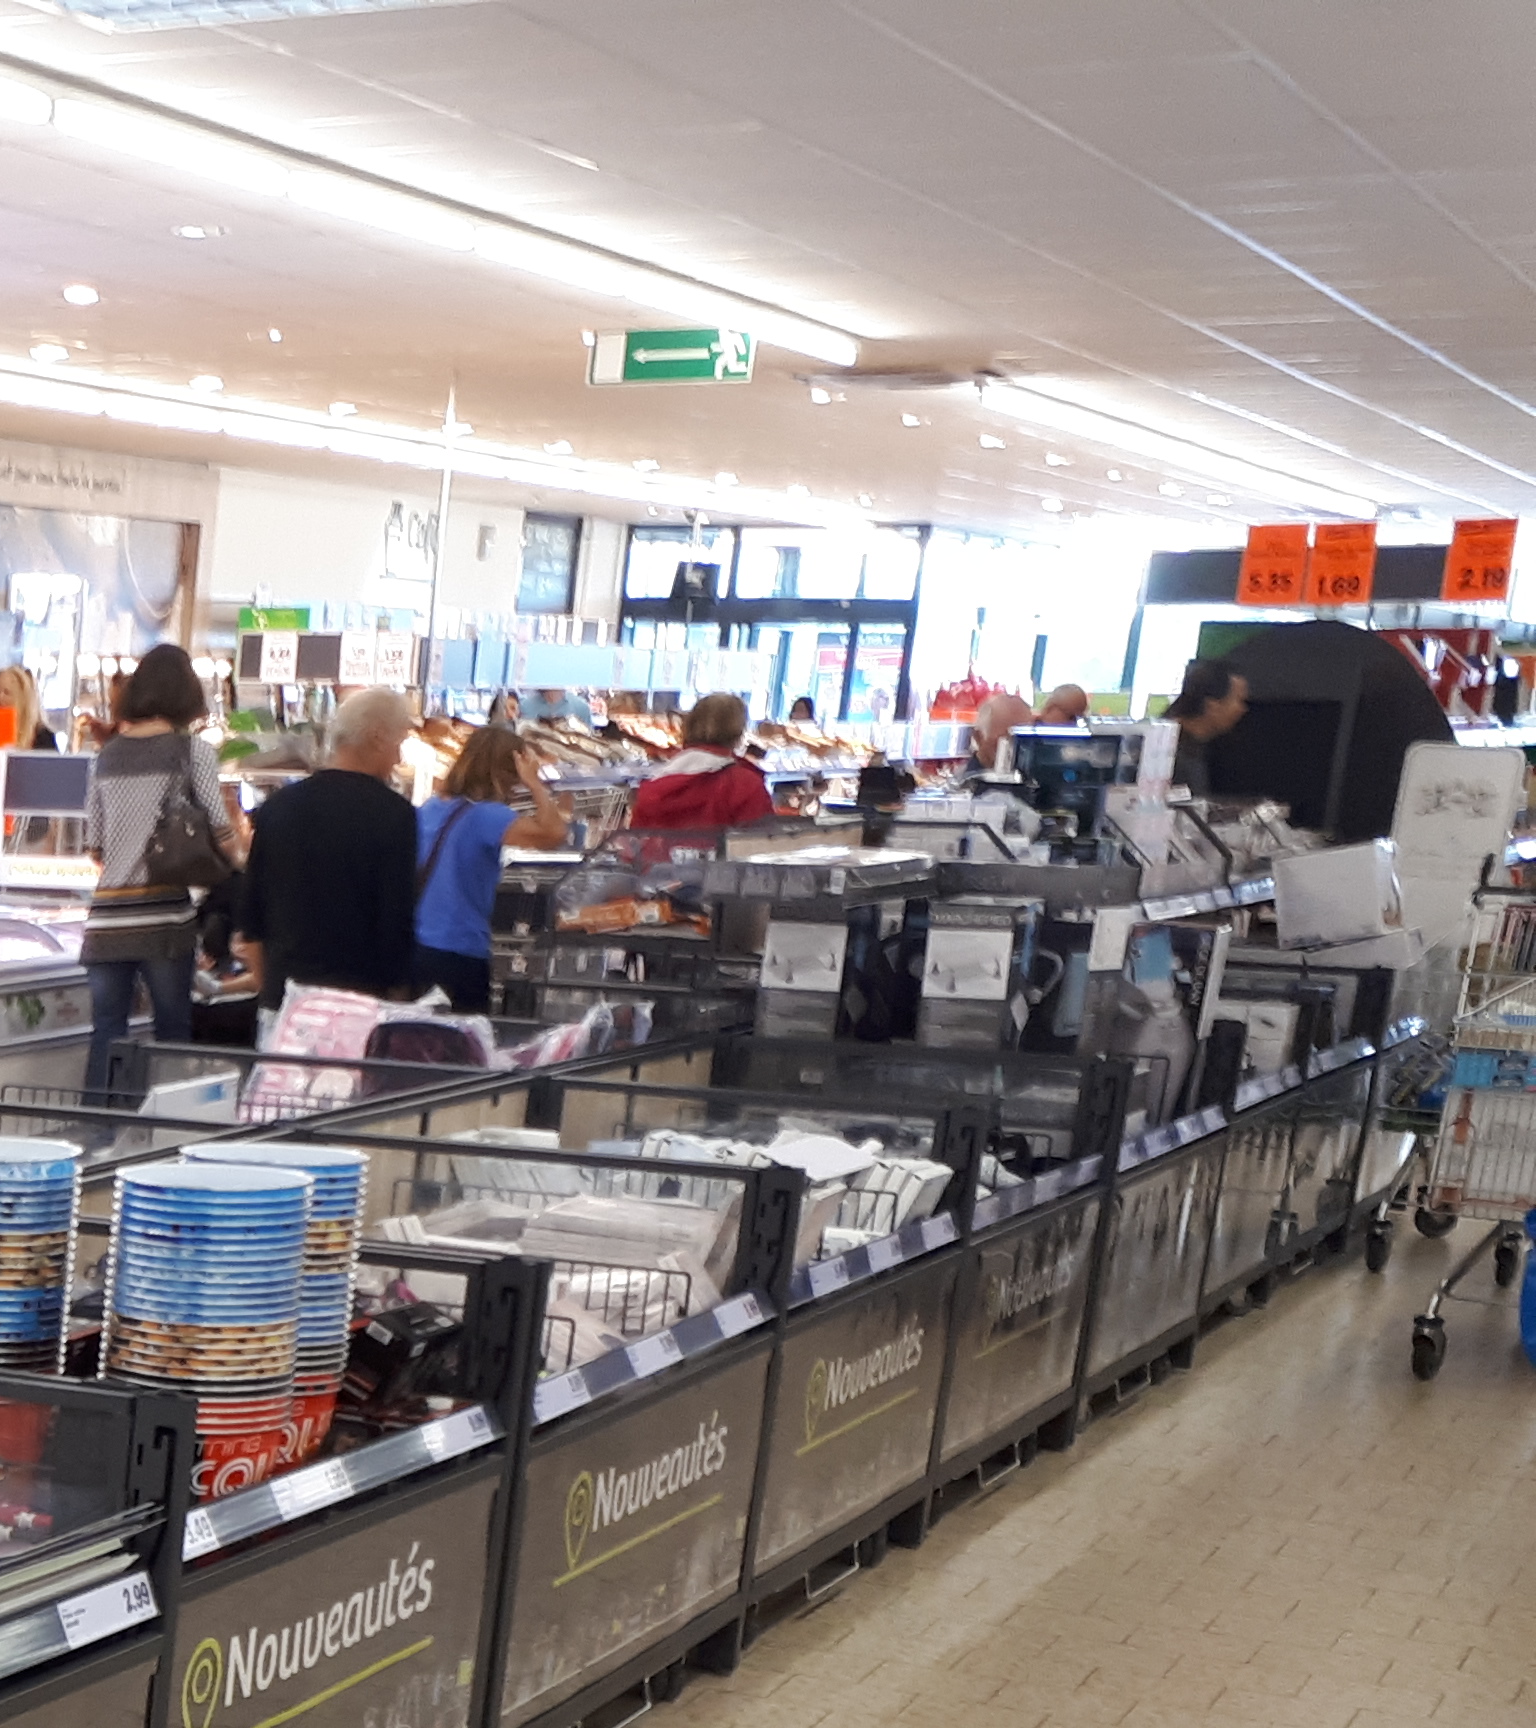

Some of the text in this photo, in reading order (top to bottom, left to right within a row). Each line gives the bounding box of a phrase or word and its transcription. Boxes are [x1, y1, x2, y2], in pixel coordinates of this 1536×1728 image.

[823, 1314, 925, 1411] Nouveautés
[592, 1409, 729, 1533] Nouveautés
[224, 1541, 435, 1706] Nouveautés
